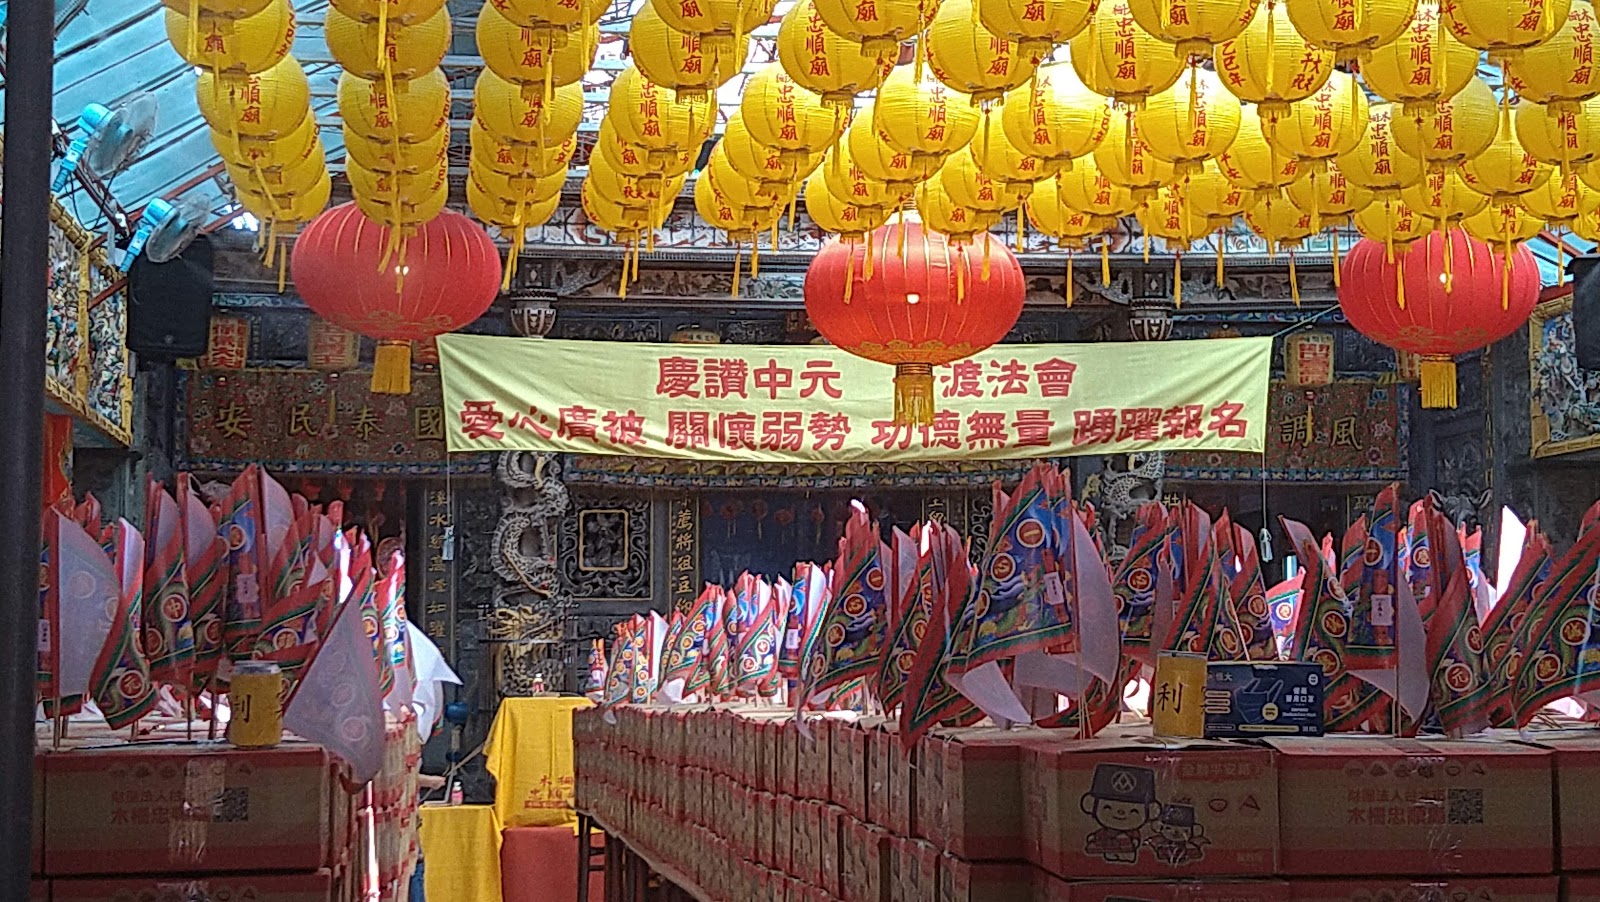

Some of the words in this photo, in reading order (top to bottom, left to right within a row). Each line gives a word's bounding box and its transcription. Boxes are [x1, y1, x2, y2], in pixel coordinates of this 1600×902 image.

[1114, 17, 1138, 80] 忠順廟
[1410, 23, 1432, 85] 忠順廟
[1569, 23, 1593, 85] 忠順廟
[776, 85, 799, 141] 忠順廟
[925, 86, 948, 141] 忠順廟
[1311, 93, 1334, 148] 忠順廟
[1370, 123, 1392, 175] 忠順廟
[656, 356, 842, 400] 慶讚中元
[893, 357, 1077, 399] 渡法會
[459, 400, 647, 446] 愛心廣被
[666, 410, 851, 451] 關懷弱勢
[871, 409, 1055, 450] 功德無量
[1071, 401, 1248, 446] 踴躍報名
[1157, 681, 1184, 714] 利
